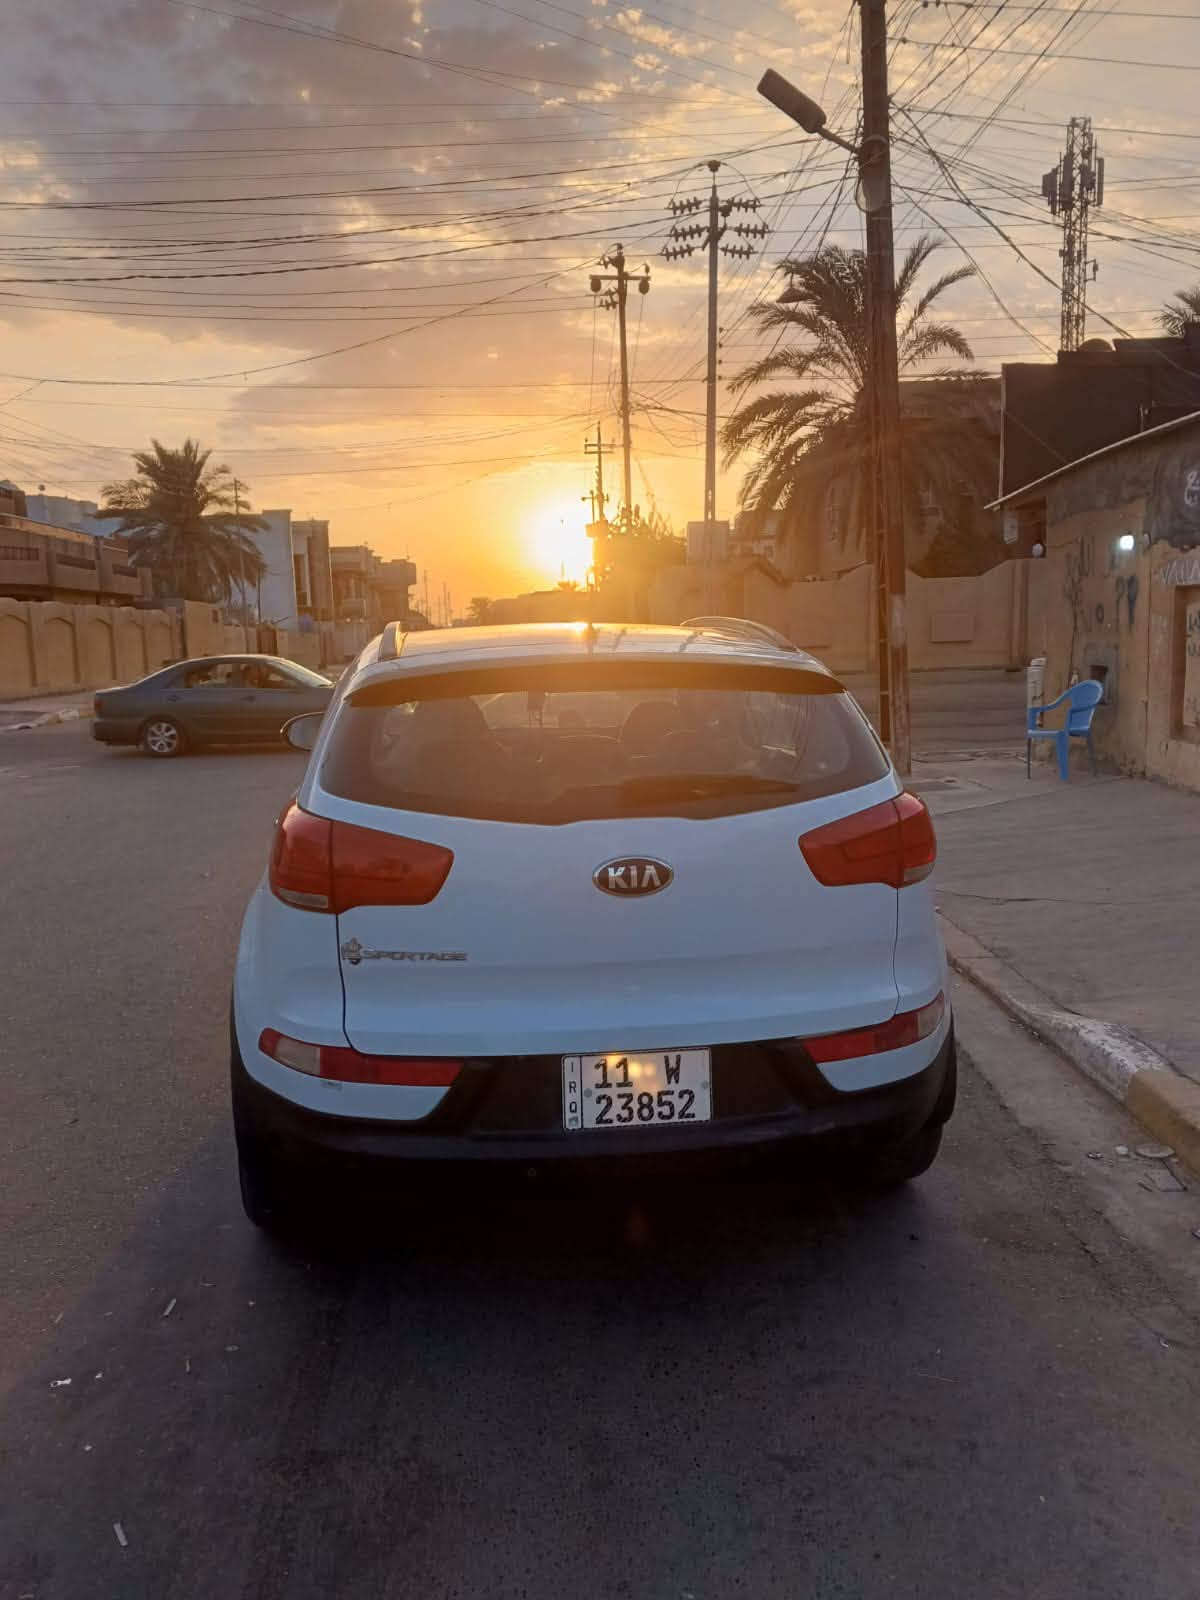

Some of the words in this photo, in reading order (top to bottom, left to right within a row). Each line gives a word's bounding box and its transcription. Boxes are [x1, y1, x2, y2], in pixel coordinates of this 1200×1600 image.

[608, 864, 661, 889] KIA
[363, 950, 468, 961] SPORTAGE
[594, 1057, 633, 1089] 11
[664, 1054, 682, 1085] W
[595, 1089, 695, 1125] 23852
